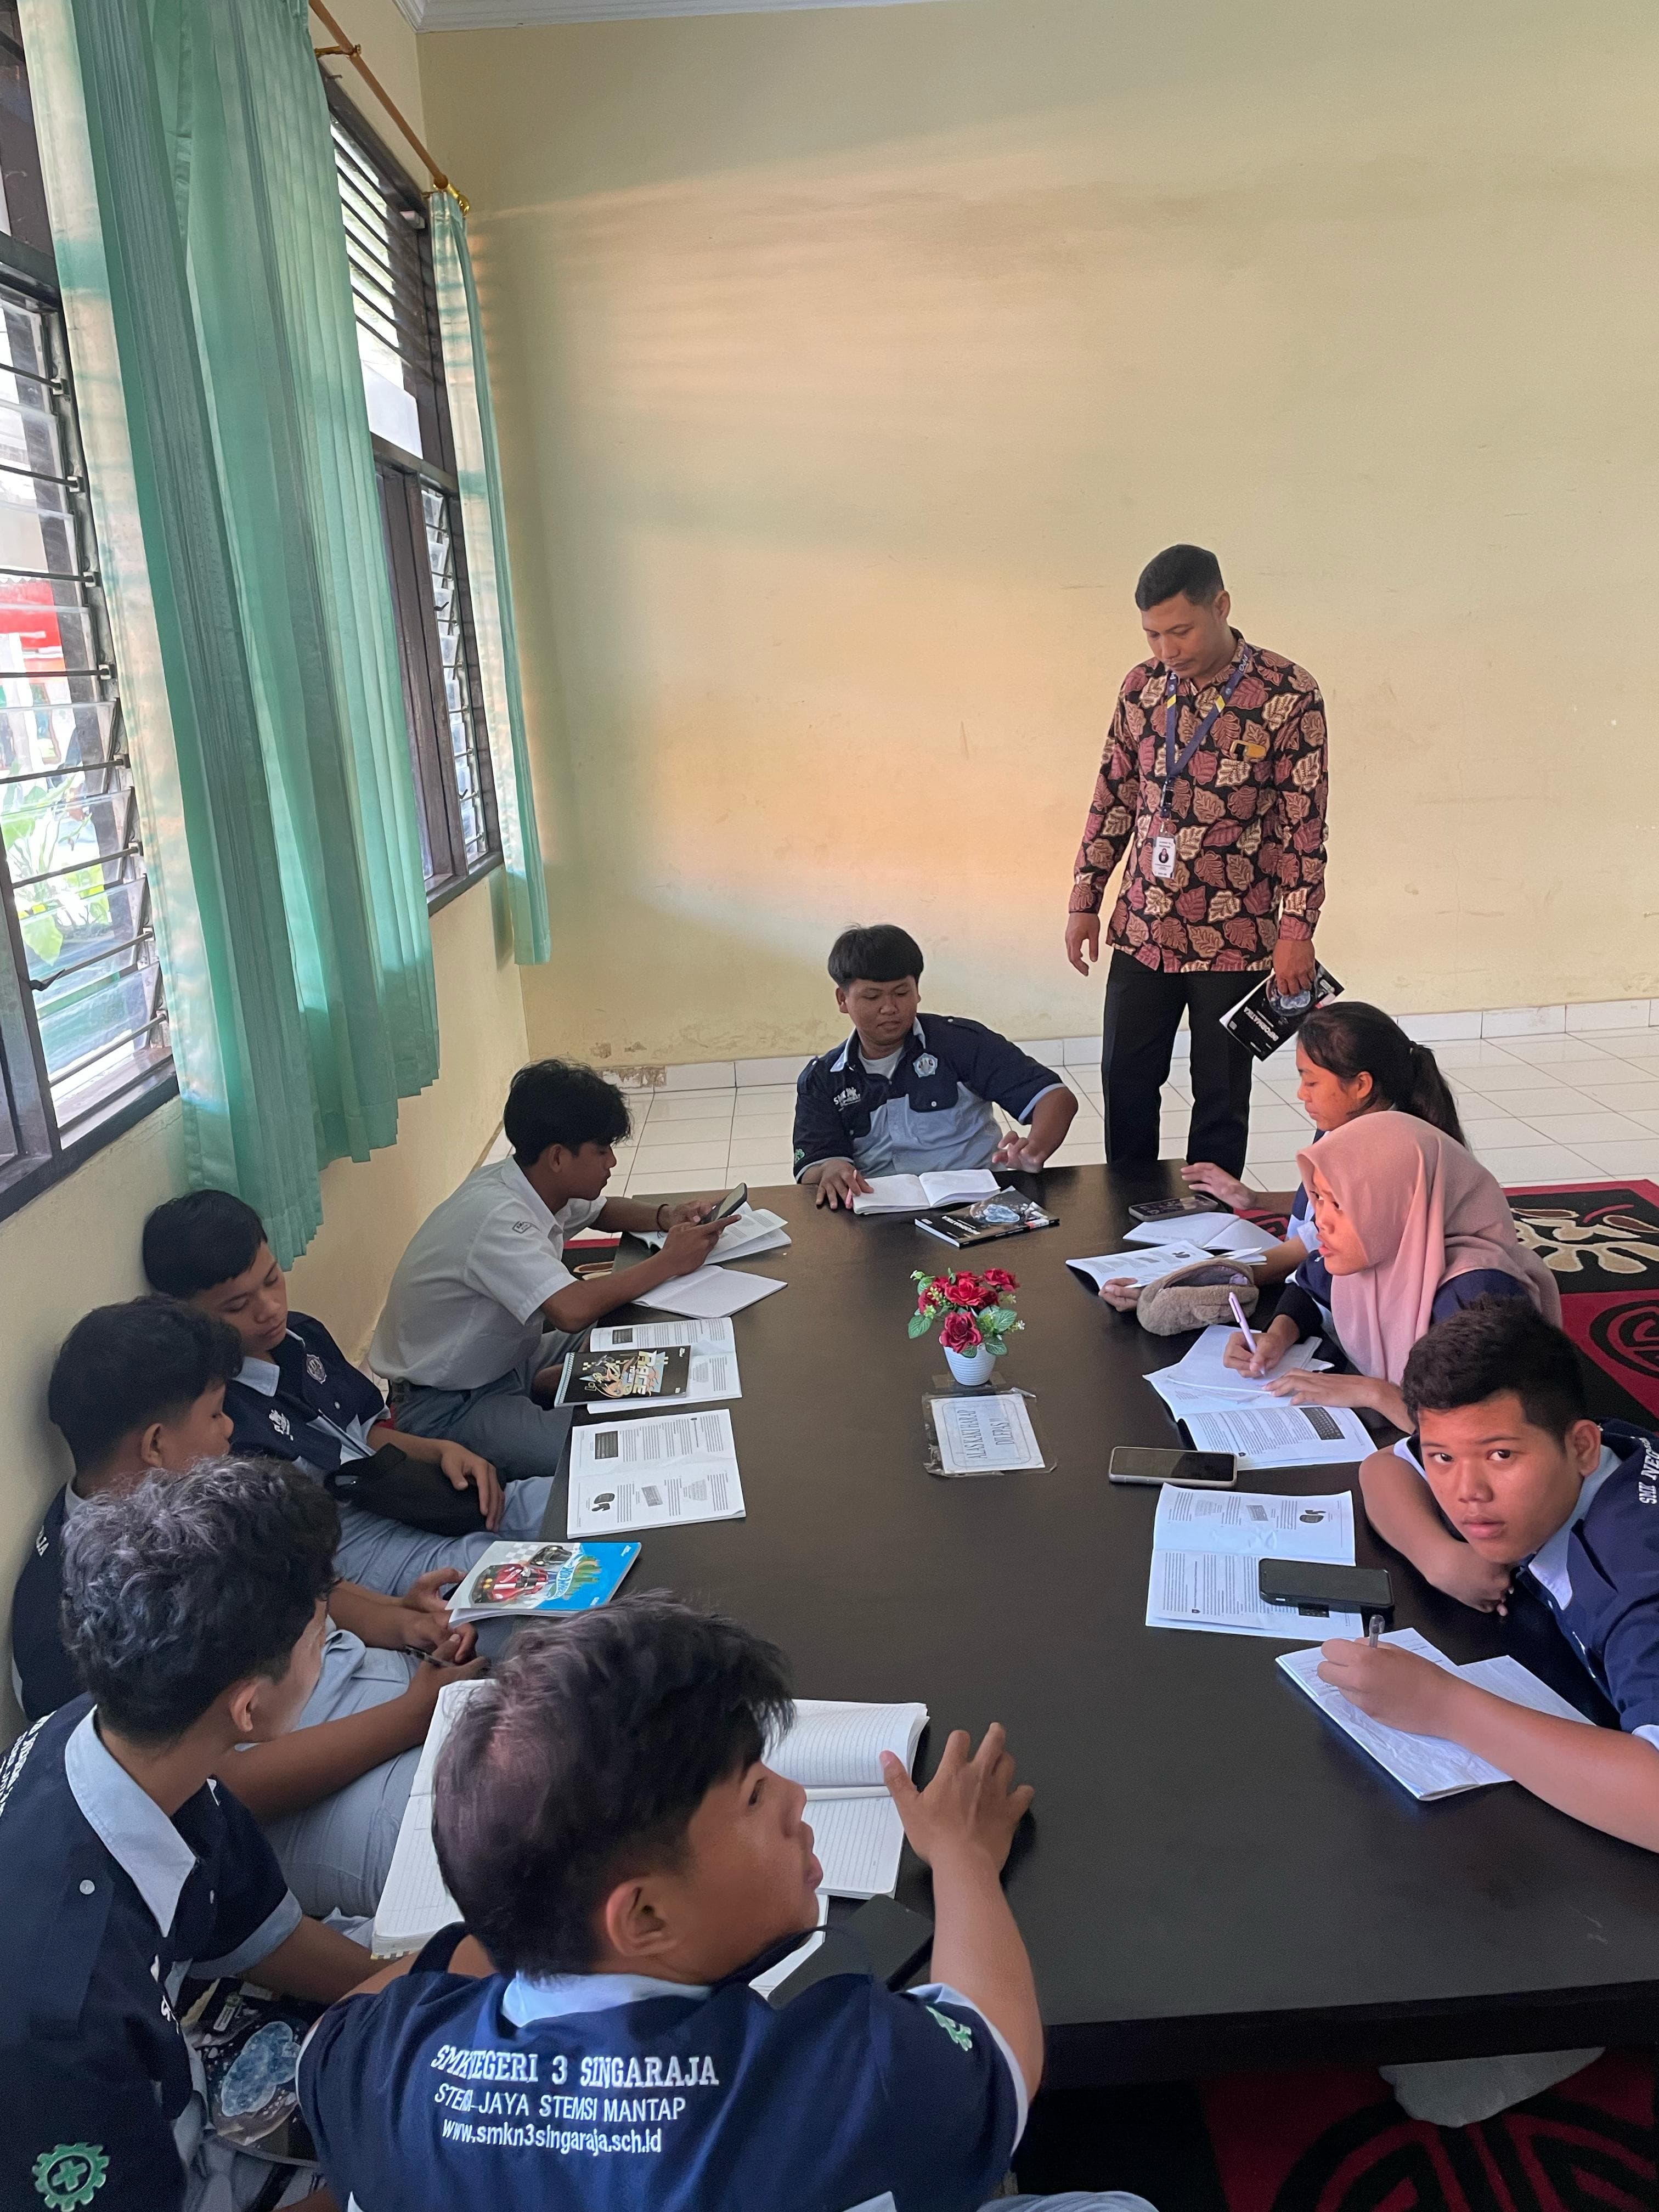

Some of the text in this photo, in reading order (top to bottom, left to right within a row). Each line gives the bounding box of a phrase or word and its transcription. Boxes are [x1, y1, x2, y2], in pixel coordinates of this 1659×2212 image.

[957, 1410, 979, 1428] HARAP
[1638, 1481, 1657, 1504] SMK
[552, 2055, 568, 2085] 3
[580, 2056, 719, 2089] SINGARAJA
[539, 2095, 597, 2121] STEMSI
[603, 2097, 686, 2123] MANTAP
[442, 2119, 662, 2156] www.smkn3singaraja.sch.id
